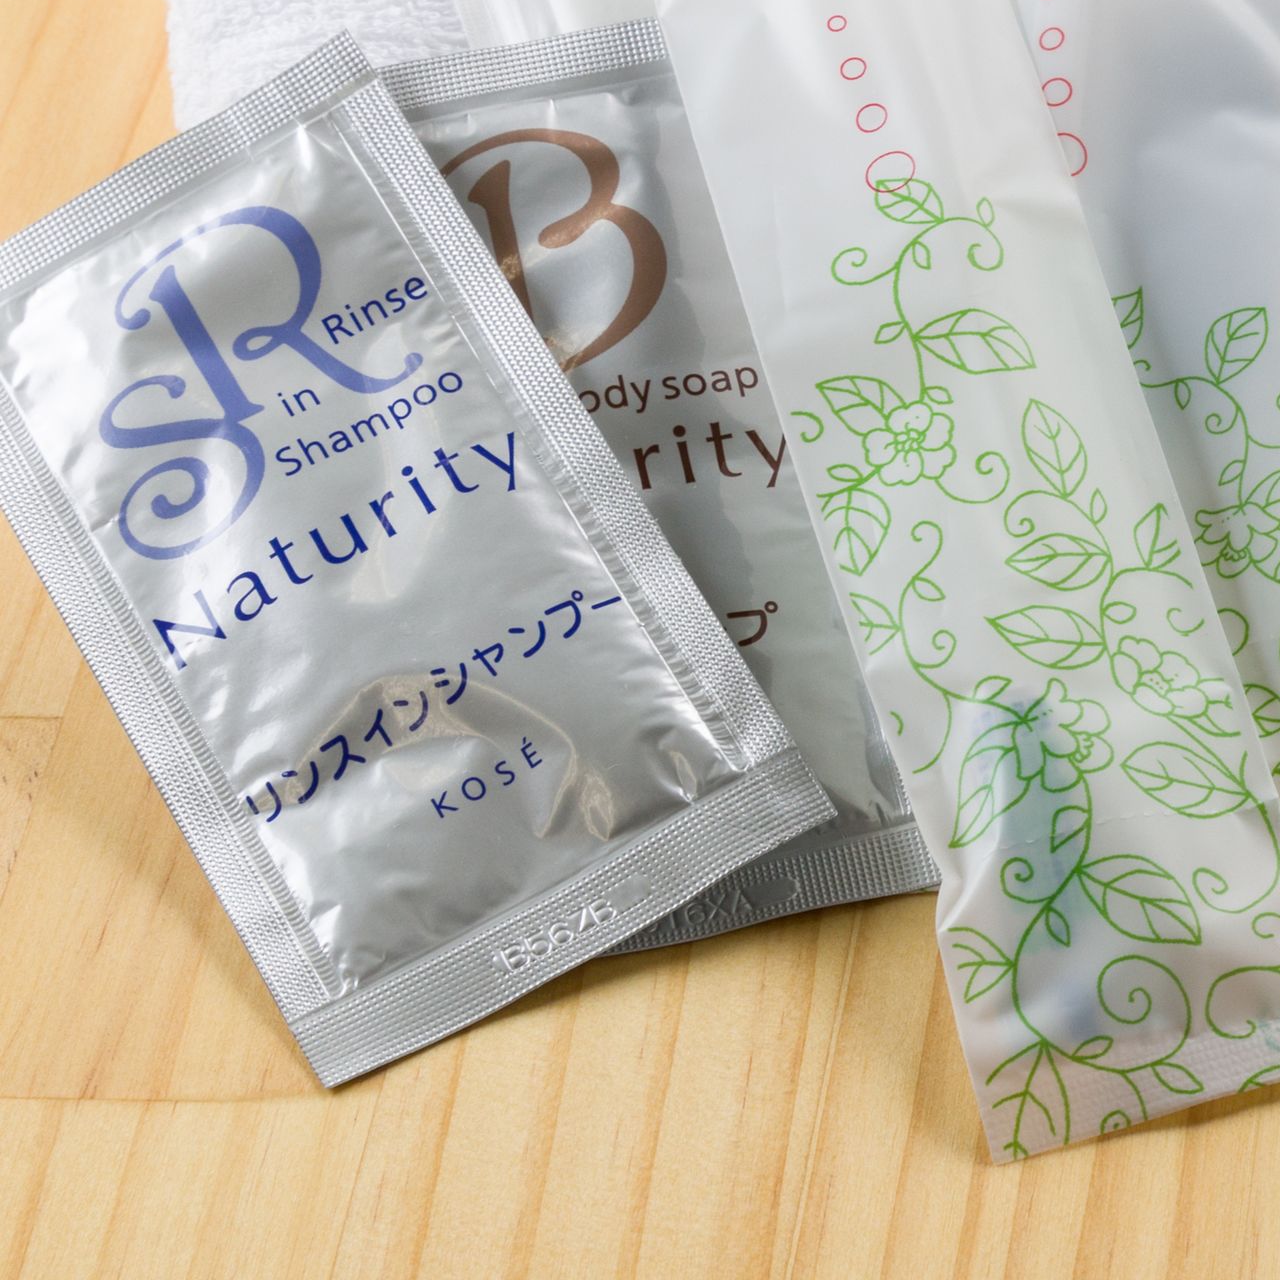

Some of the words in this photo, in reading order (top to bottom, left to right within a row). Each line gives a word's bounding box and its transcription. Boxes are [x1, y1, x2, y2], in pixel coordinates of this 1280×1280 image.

[322, 274, 428, 345] Rinse
[275, 366, 463, 475] Shampoo
[280, 383, 320, 417] in
[579, 374, 651, 413] ody
[662, 367, 759, 400] soap
[152, 430, 519, 672] Naturity
[246, 591, 623, 823] リンスインシャンプー
[430, 743, 543, 819] KOSÉ
